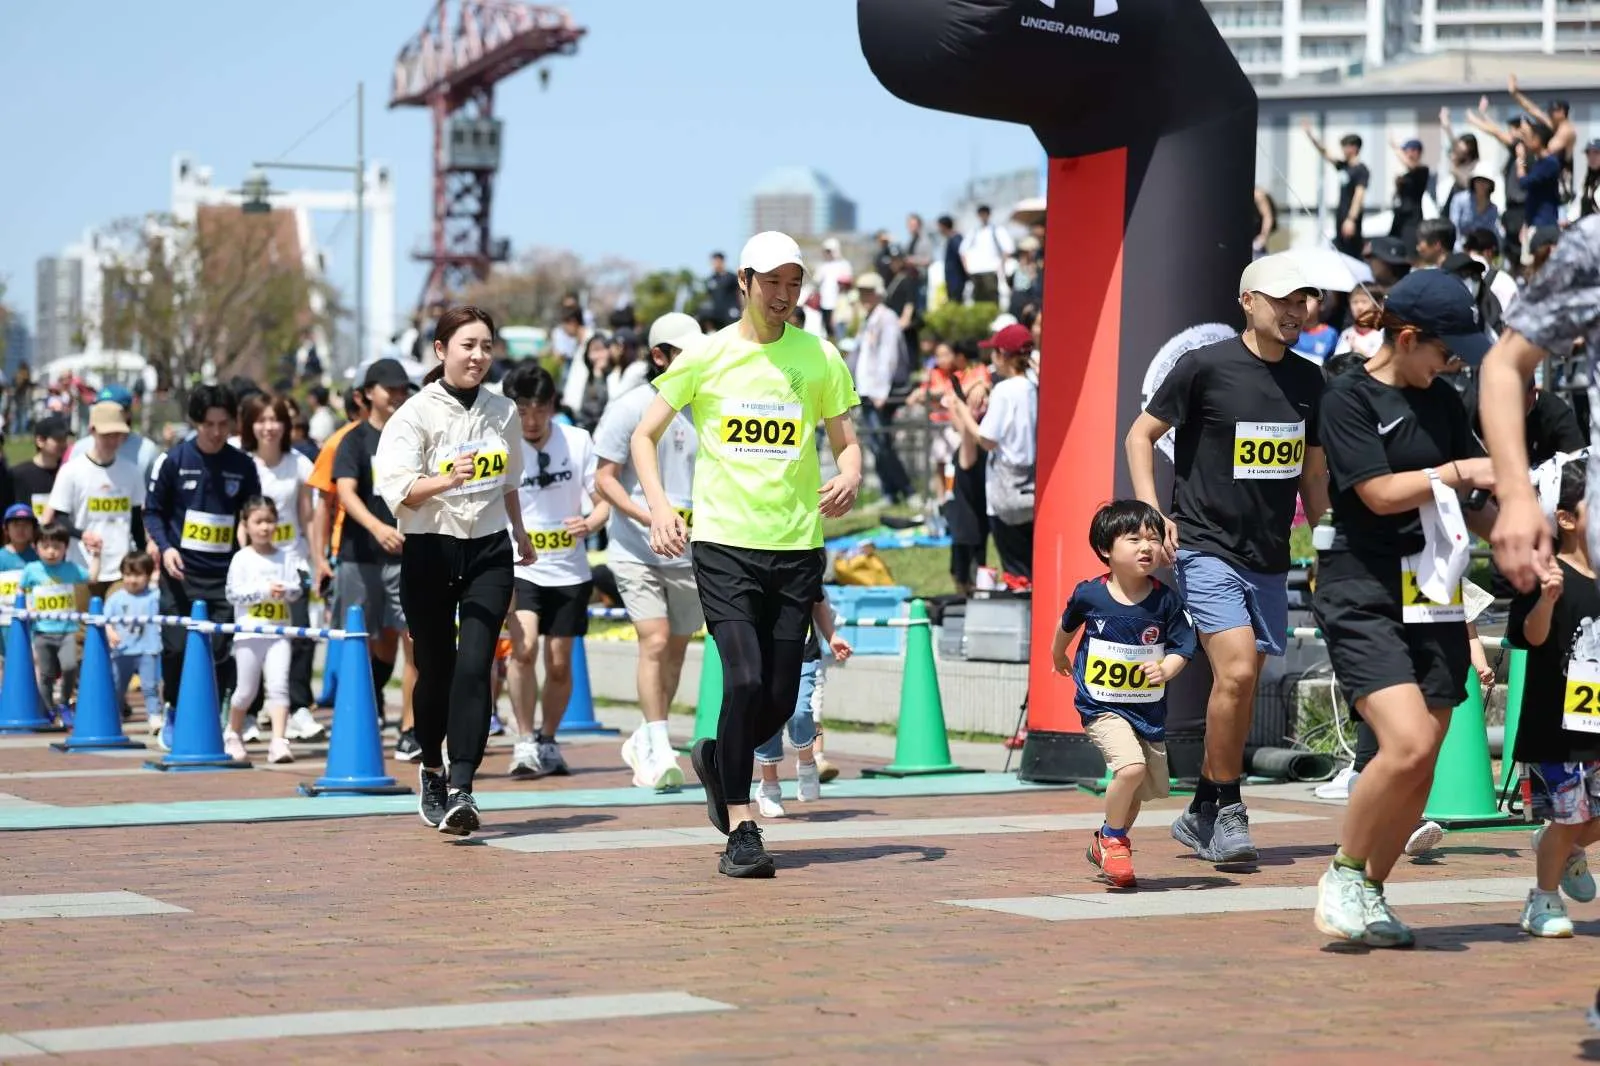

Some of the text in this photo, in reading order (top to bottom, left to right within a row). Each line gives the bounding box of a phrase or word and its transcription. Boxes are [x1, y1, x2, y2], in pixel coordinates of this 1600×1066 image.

[1020, 15, 1120, 44] UNDER ARMOUR
[727, 419, 796, 445] 2902
[1240, 440, 1303, 465] 3090
[188, 524, 232, 542] 2918
[527, 531, 573, 549] 939
